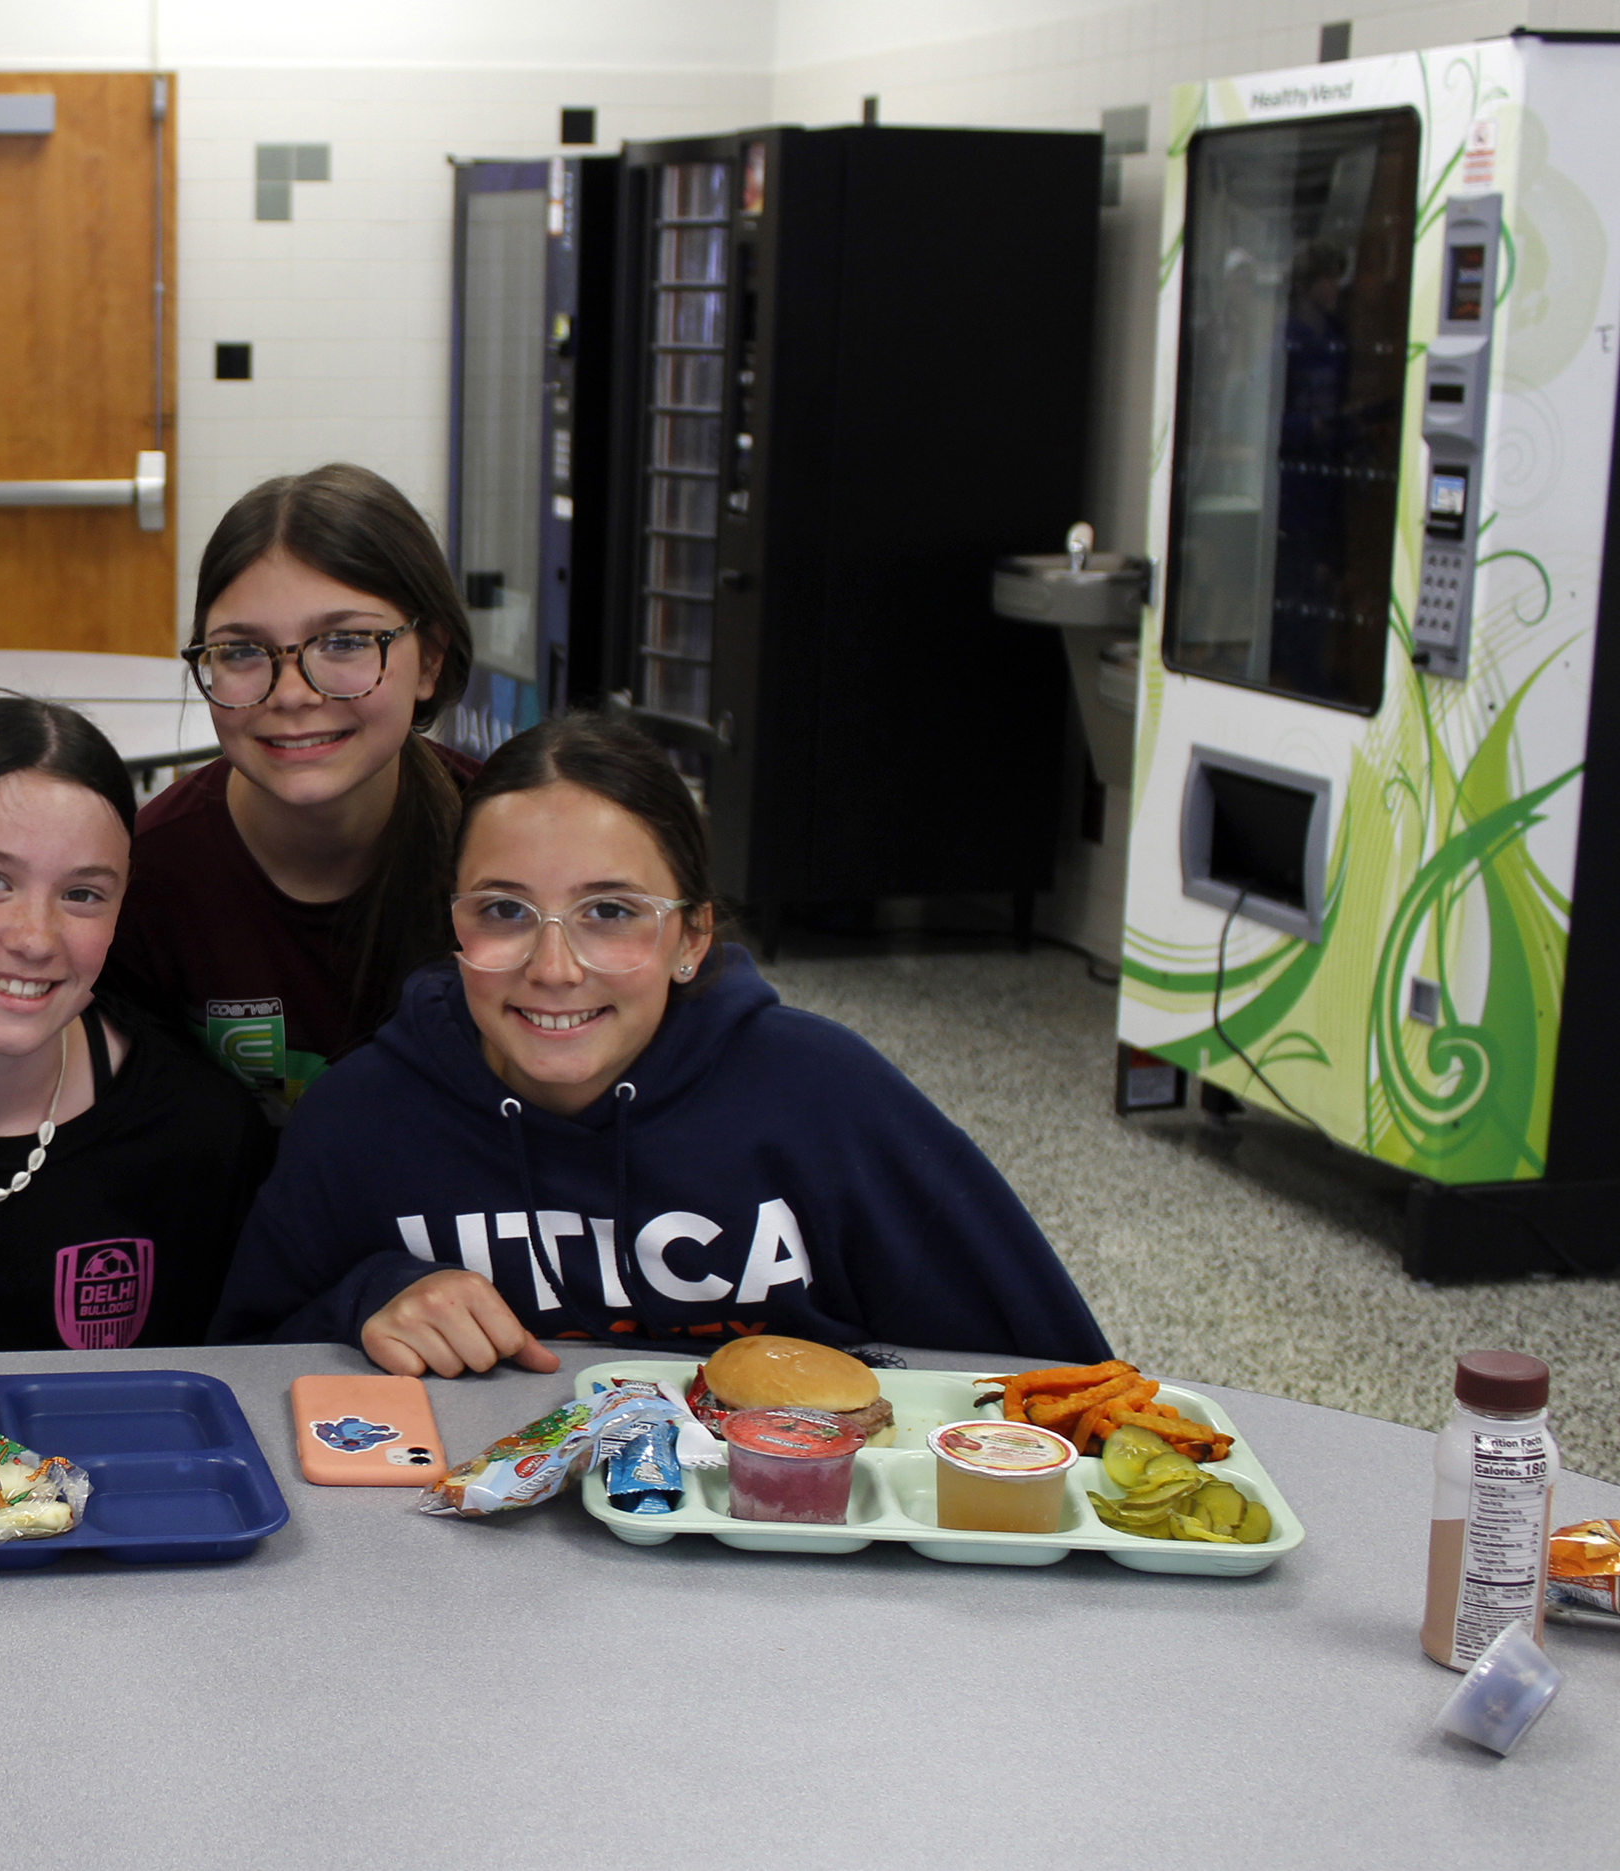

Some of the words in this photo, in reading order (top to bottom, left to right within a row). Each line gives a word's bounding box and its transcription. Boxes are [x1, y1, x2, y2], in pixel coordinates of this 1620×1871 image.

[397, 1198, 813, 1311] UTICA
[80, 1281, 137, 1305] DELHI
[80, 1301, 136, 1316] BULLDOGS
[1474, 1463, 1522, 1477] Calories
[1524, 1461, 1547, 1476] 180
